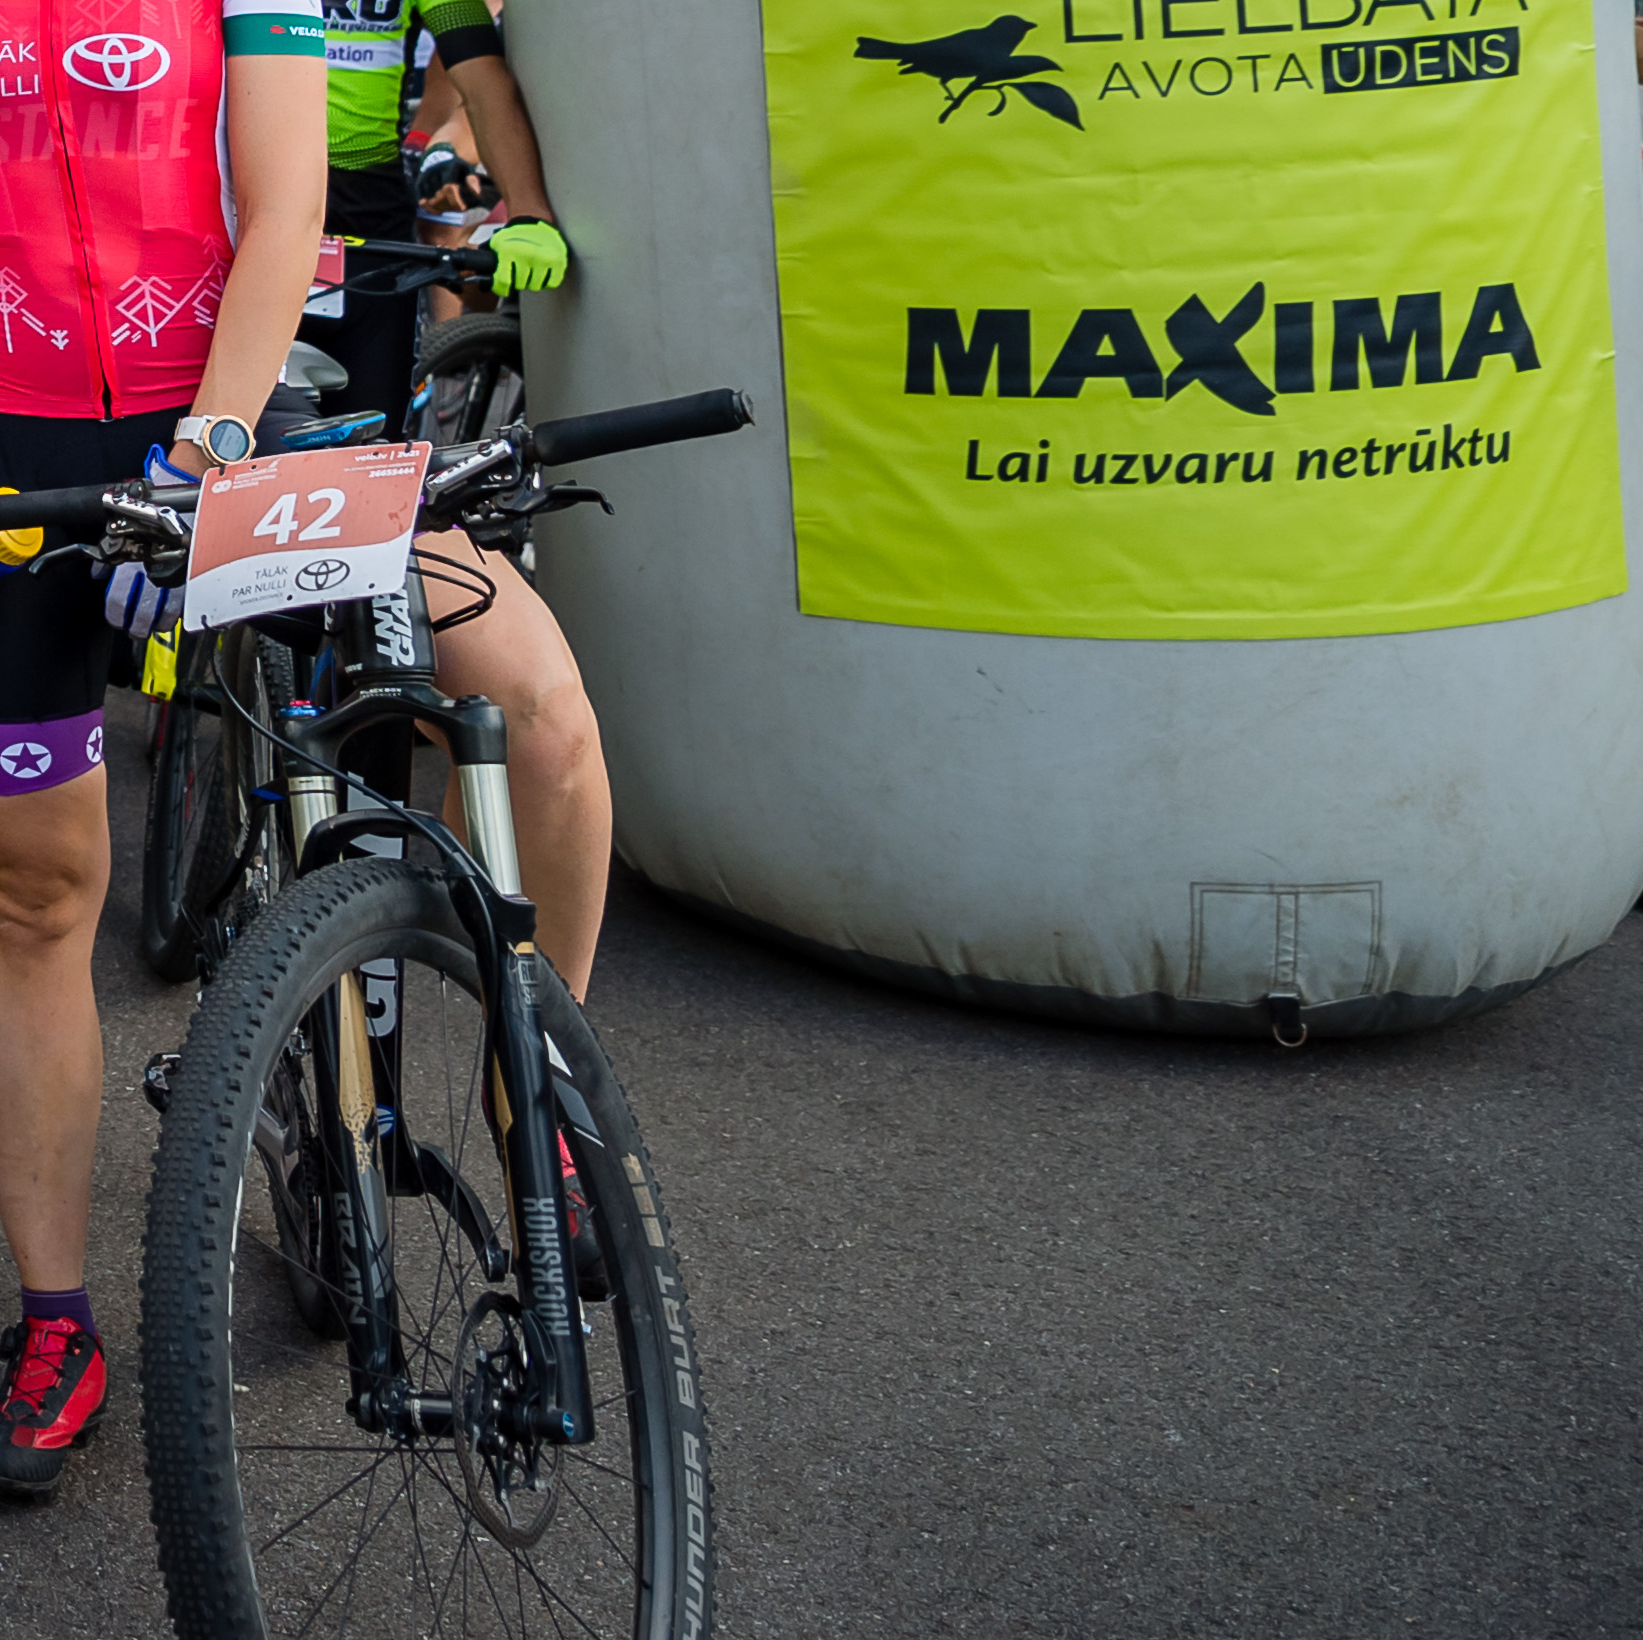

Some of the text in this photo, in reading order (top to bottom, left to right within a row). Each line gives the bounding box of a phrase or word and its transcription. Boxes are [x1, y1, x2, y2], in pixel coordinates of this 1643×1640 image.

[1097, 33, 1512, 101] AVOTA ŪDENS
[904, 280, 1543, 418] MAXIMA
[965, 423, 1513, 485] Lai uzvaru netrūktu
[252, 487, 347, 546] 42
[231, 579, 287, 599] PAR NULLI
[523, 1196, 571, 1337] ROCKSHOX
[654, 1265, 709, 1640] HUNDER BURT
